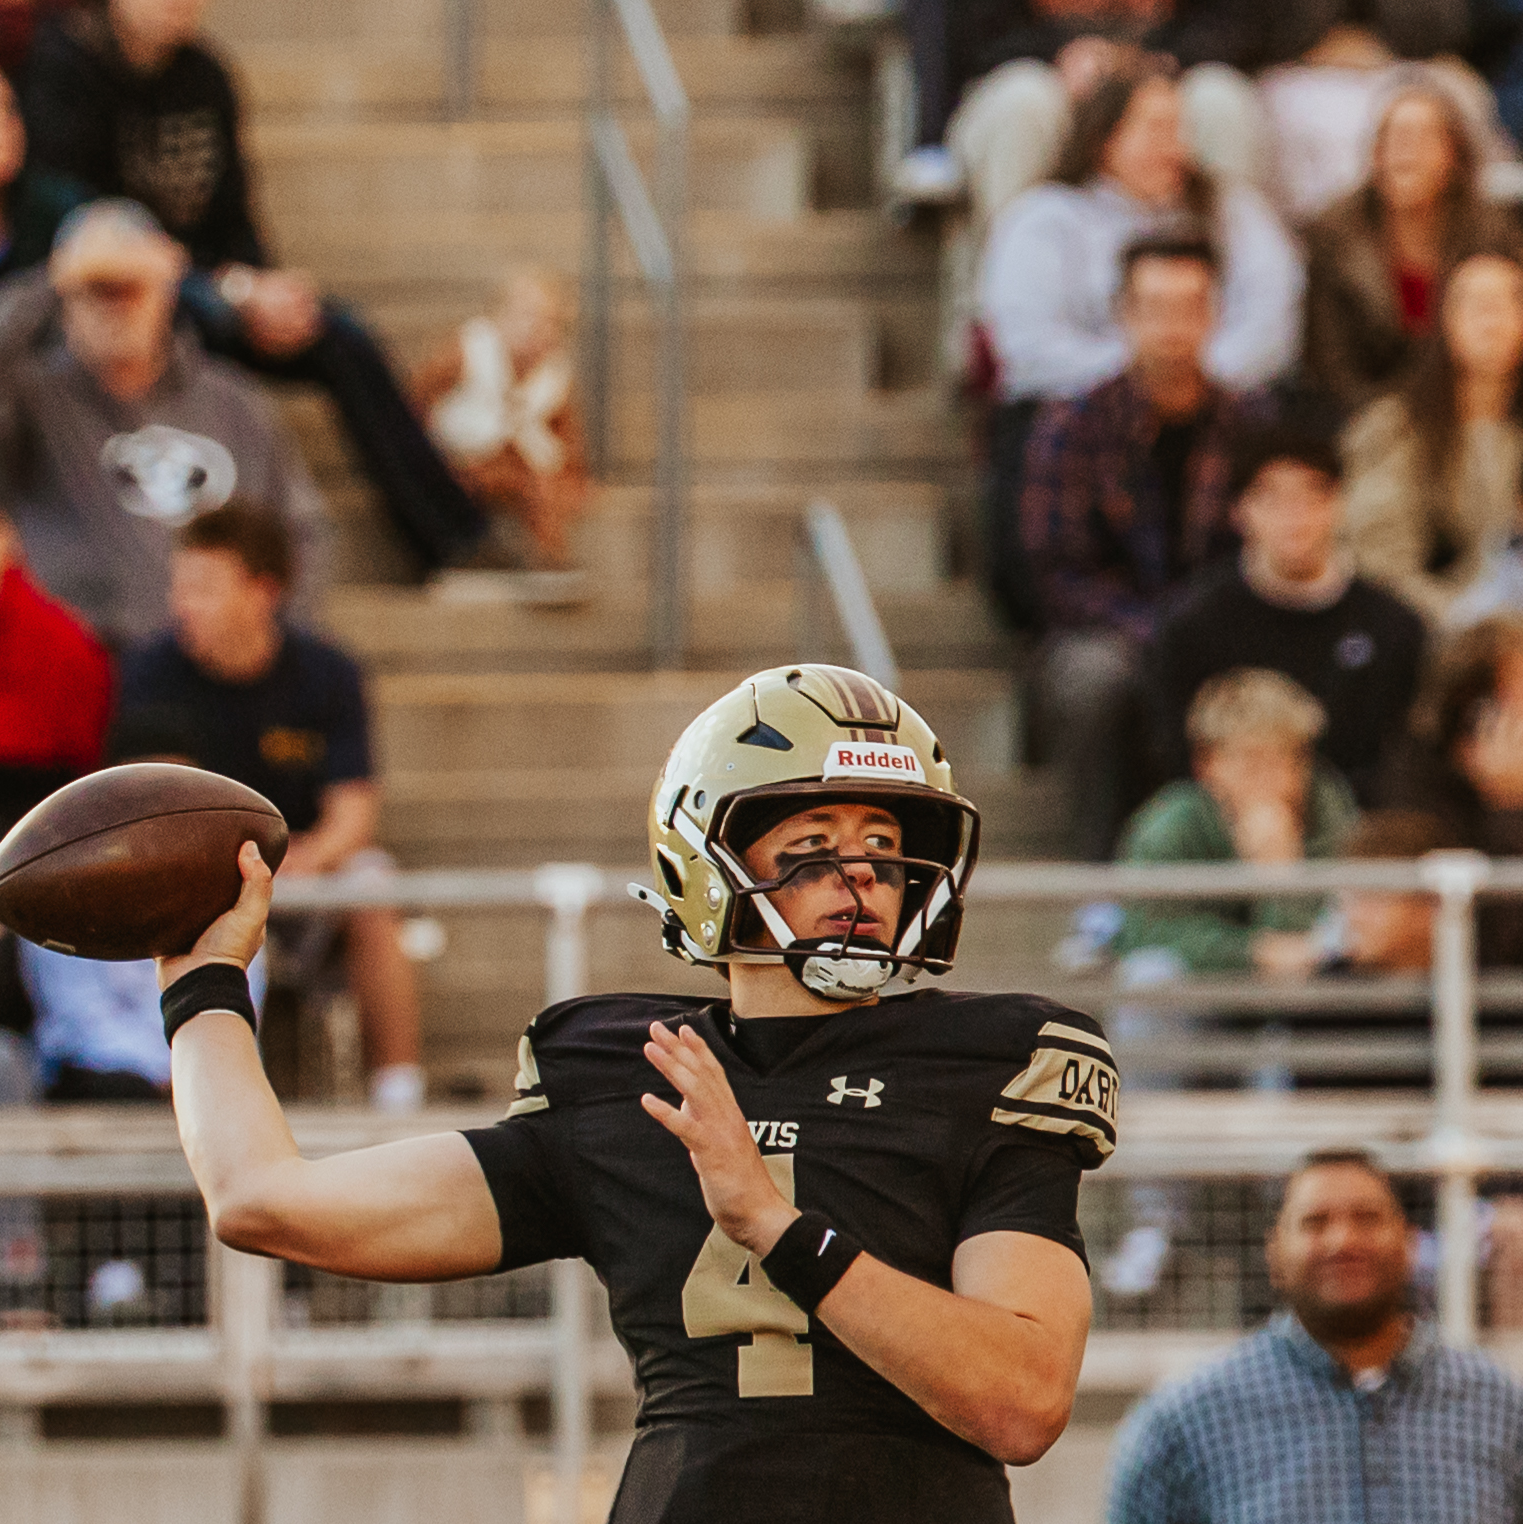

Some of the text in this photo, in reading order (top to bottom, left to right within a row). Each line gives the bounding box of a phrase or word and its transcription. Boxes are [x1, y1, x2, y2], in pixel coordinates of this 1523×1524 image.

[837, 750, 917, 772] Riddell
[747, 1121, 800, 1148] VIS
[682, 1153, 814, 1398] 4
